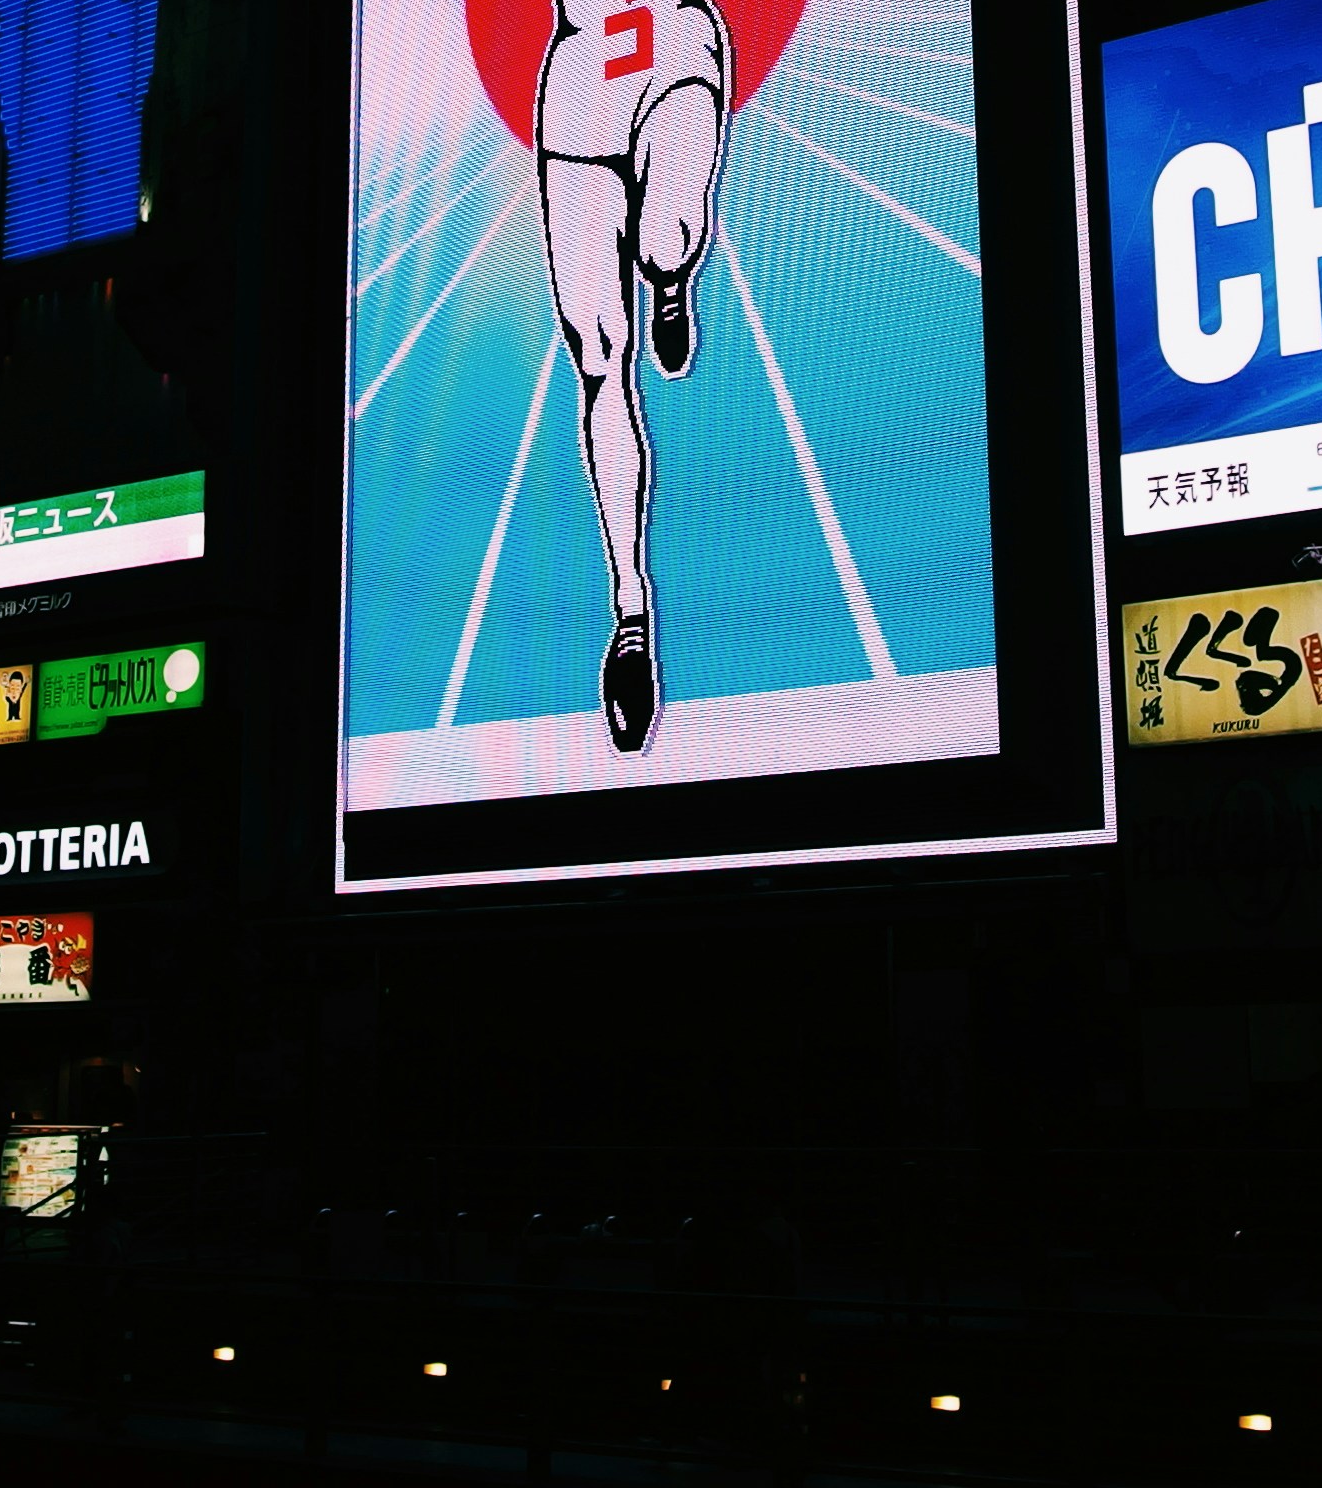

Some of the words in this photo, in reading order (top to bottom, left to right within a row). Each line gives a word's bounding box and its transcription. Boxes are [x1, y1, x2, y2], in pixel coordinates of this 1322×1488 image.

[1146, 463, 1251, 510] 天気予報
[1163, 605, 1304, 717] くくる
[1211, 718, 1261, 734] KUKURU
